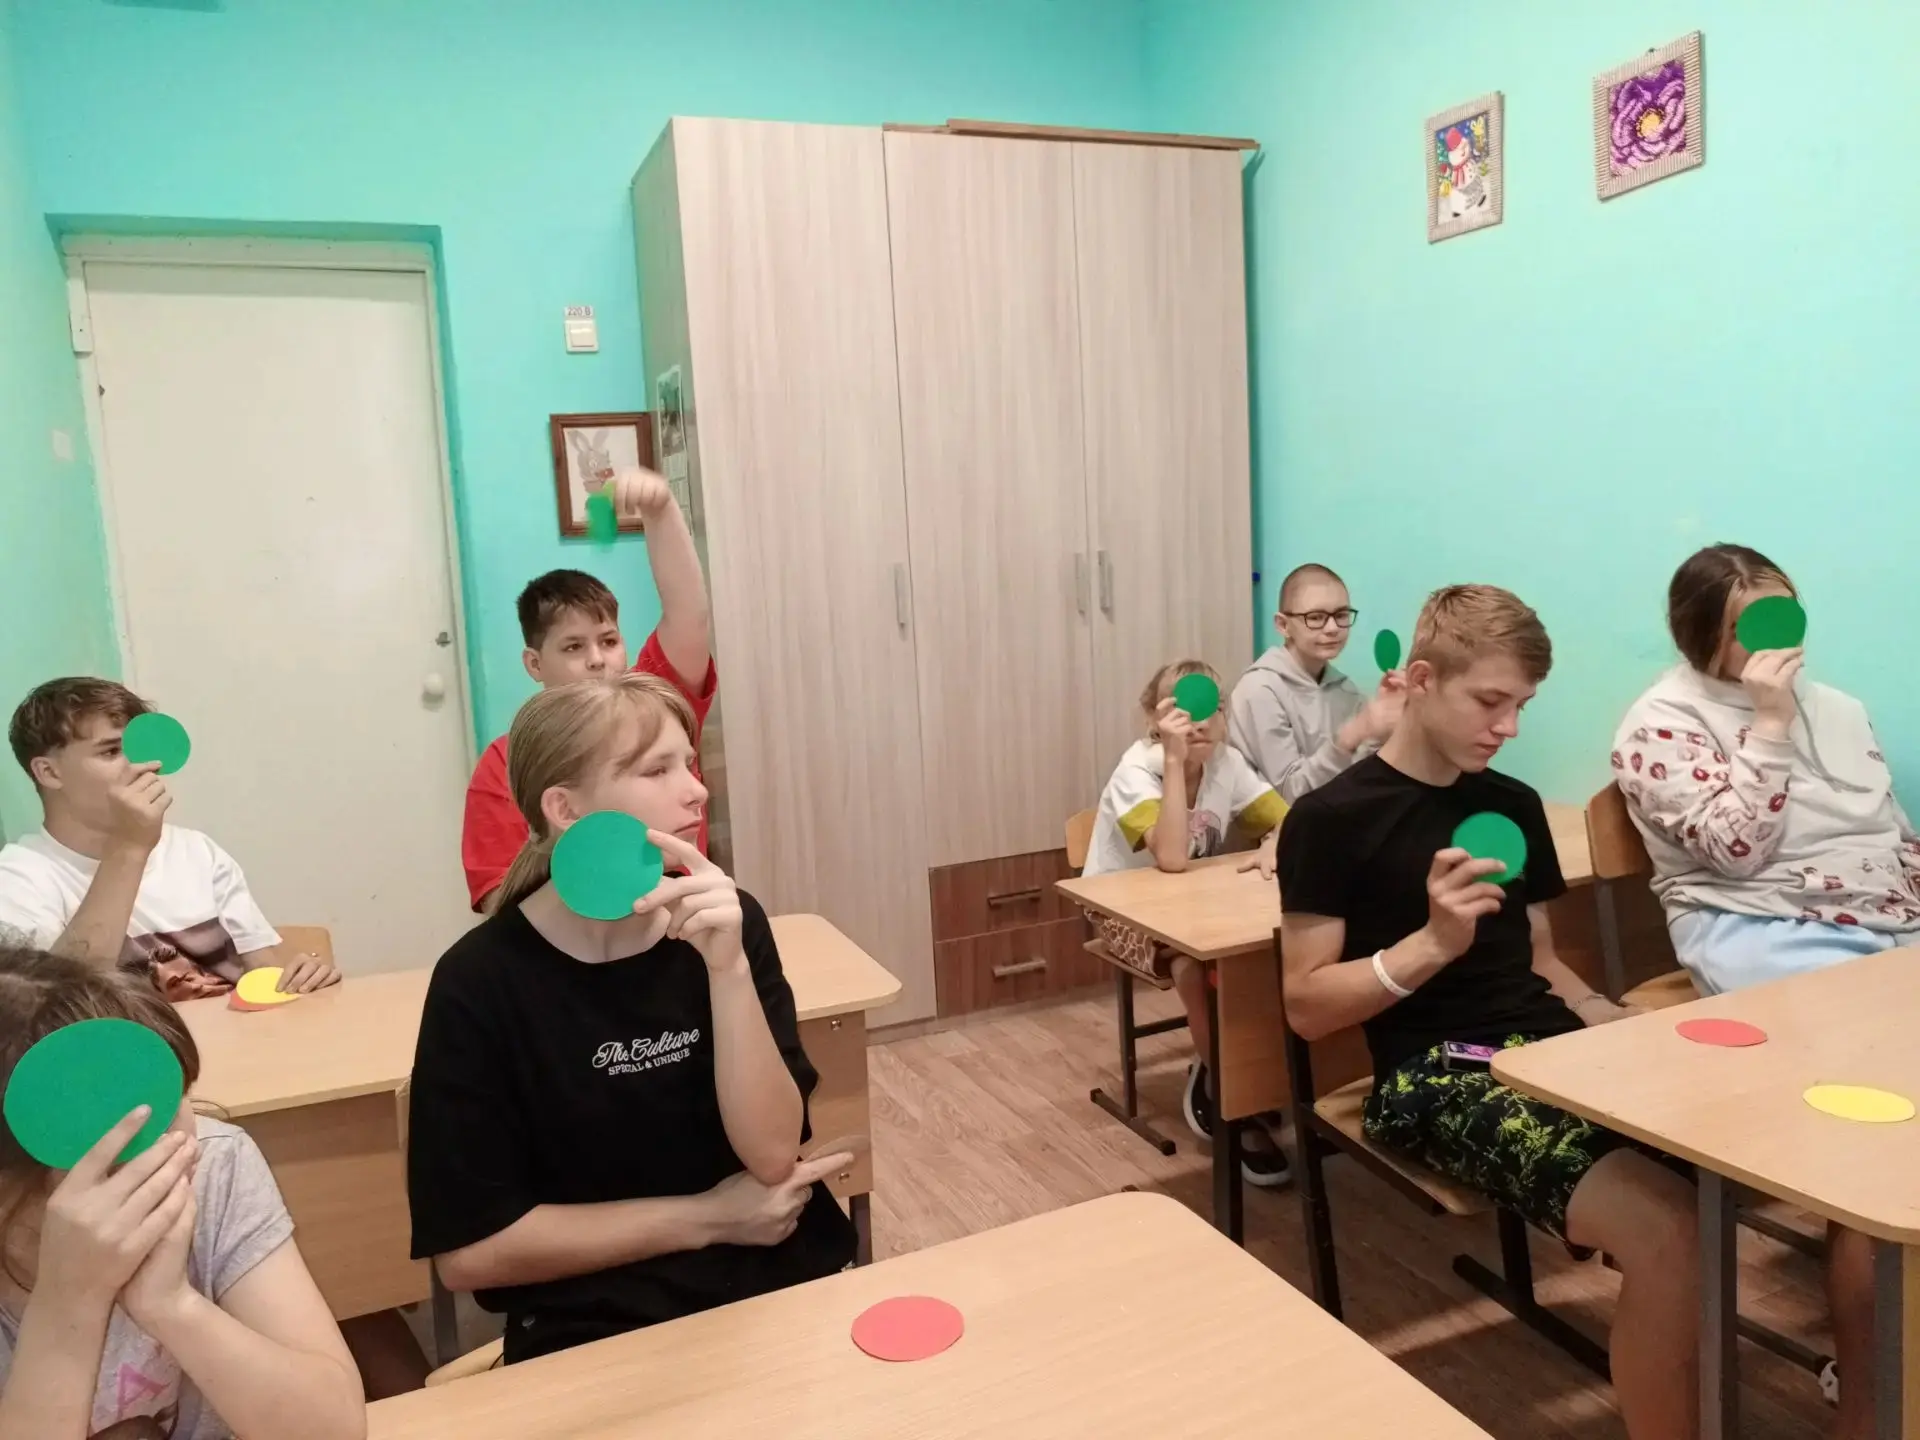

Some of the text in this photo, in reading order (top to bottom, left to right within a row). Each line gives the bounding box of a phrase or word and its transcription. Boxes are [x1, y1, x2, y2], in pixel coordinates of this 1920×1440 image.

[567, 306, 583, 317] 220
[592, 1028, 700, 1068] The Culture
[645, 1060, 653, 1069] &
[653, 1047, 691, 1067] UNIQUE
